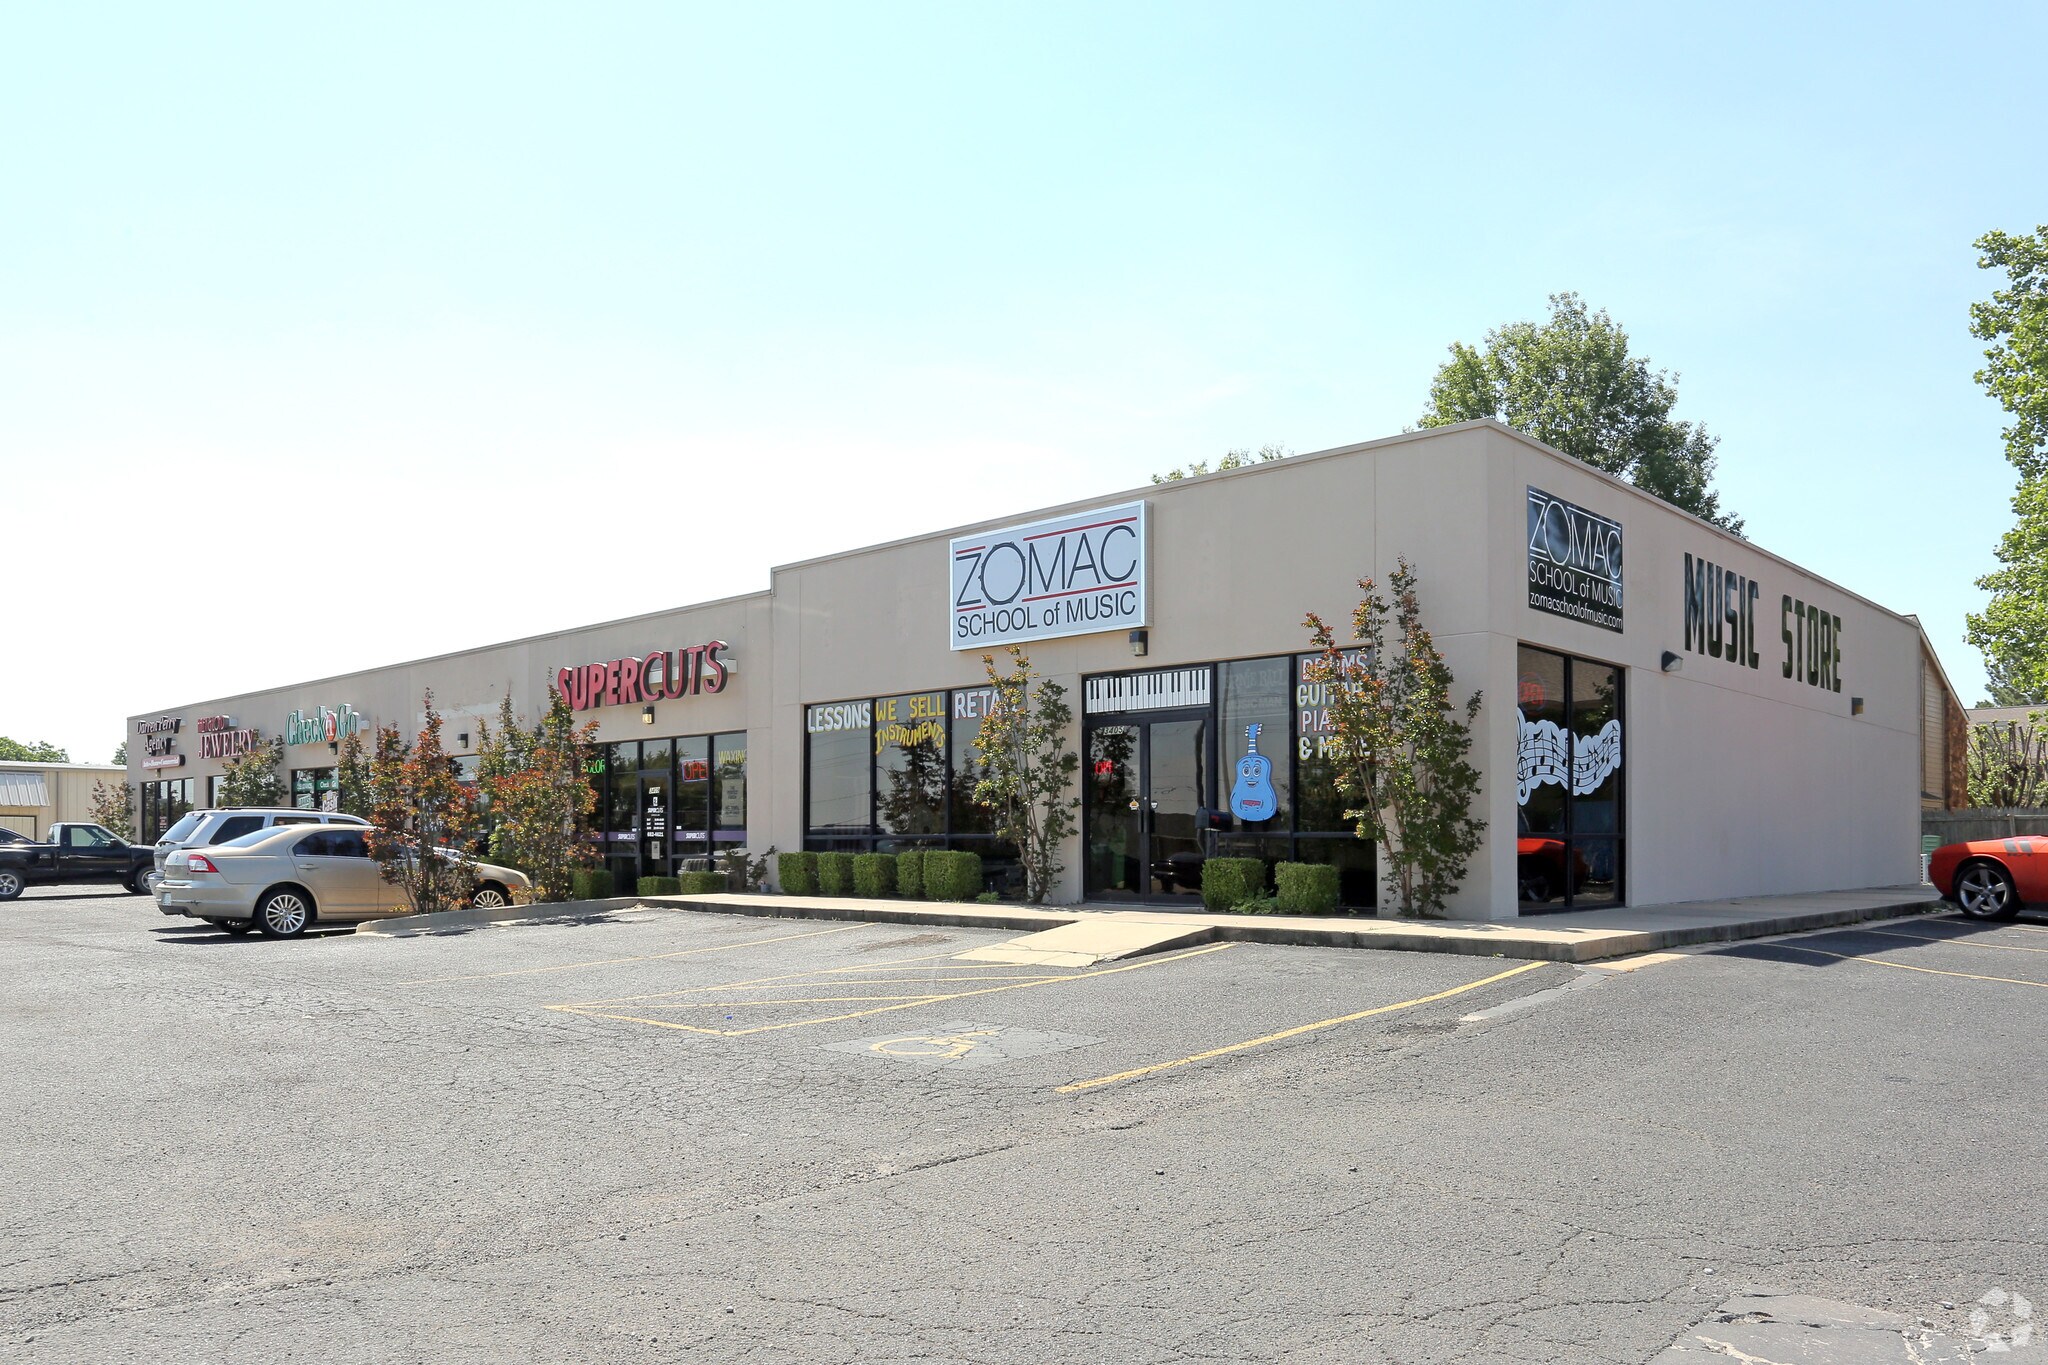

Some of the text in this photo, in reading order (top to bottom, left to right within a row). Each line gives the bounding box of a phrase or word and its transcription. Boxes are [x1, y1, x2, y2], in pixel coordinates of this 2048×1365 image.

[1529, 497, 1621, 579] ZOMAC
[956, 525, 1137, 606] ZOMAC
[1530, 560, 1622, 609] SCHOOL of MUSIC
[957, 590, 1136, 638] SCHOOL of MUSIC
[1530, 592, 1622, 629] zomacschoolofmusic.com
[1684, 552, 1842, 694] MUSIC STORE
[558, 640, 728, 711] SUPERCUTS
[807, 702, 871, 734] LESSONS
[876, 695, 945, 722] WE SELL
[954, 689, 1018, 719] RETA
[286, 705, 326, 746] Check
[336, 703, 357, 740] Go
[875, 721, 945, 755] INSTRUMENTS
[1103, 725, 1124, 736] 3405
[198, 729, 255, 759] JEWELRY
[1298, 736, 1313, 761] &
